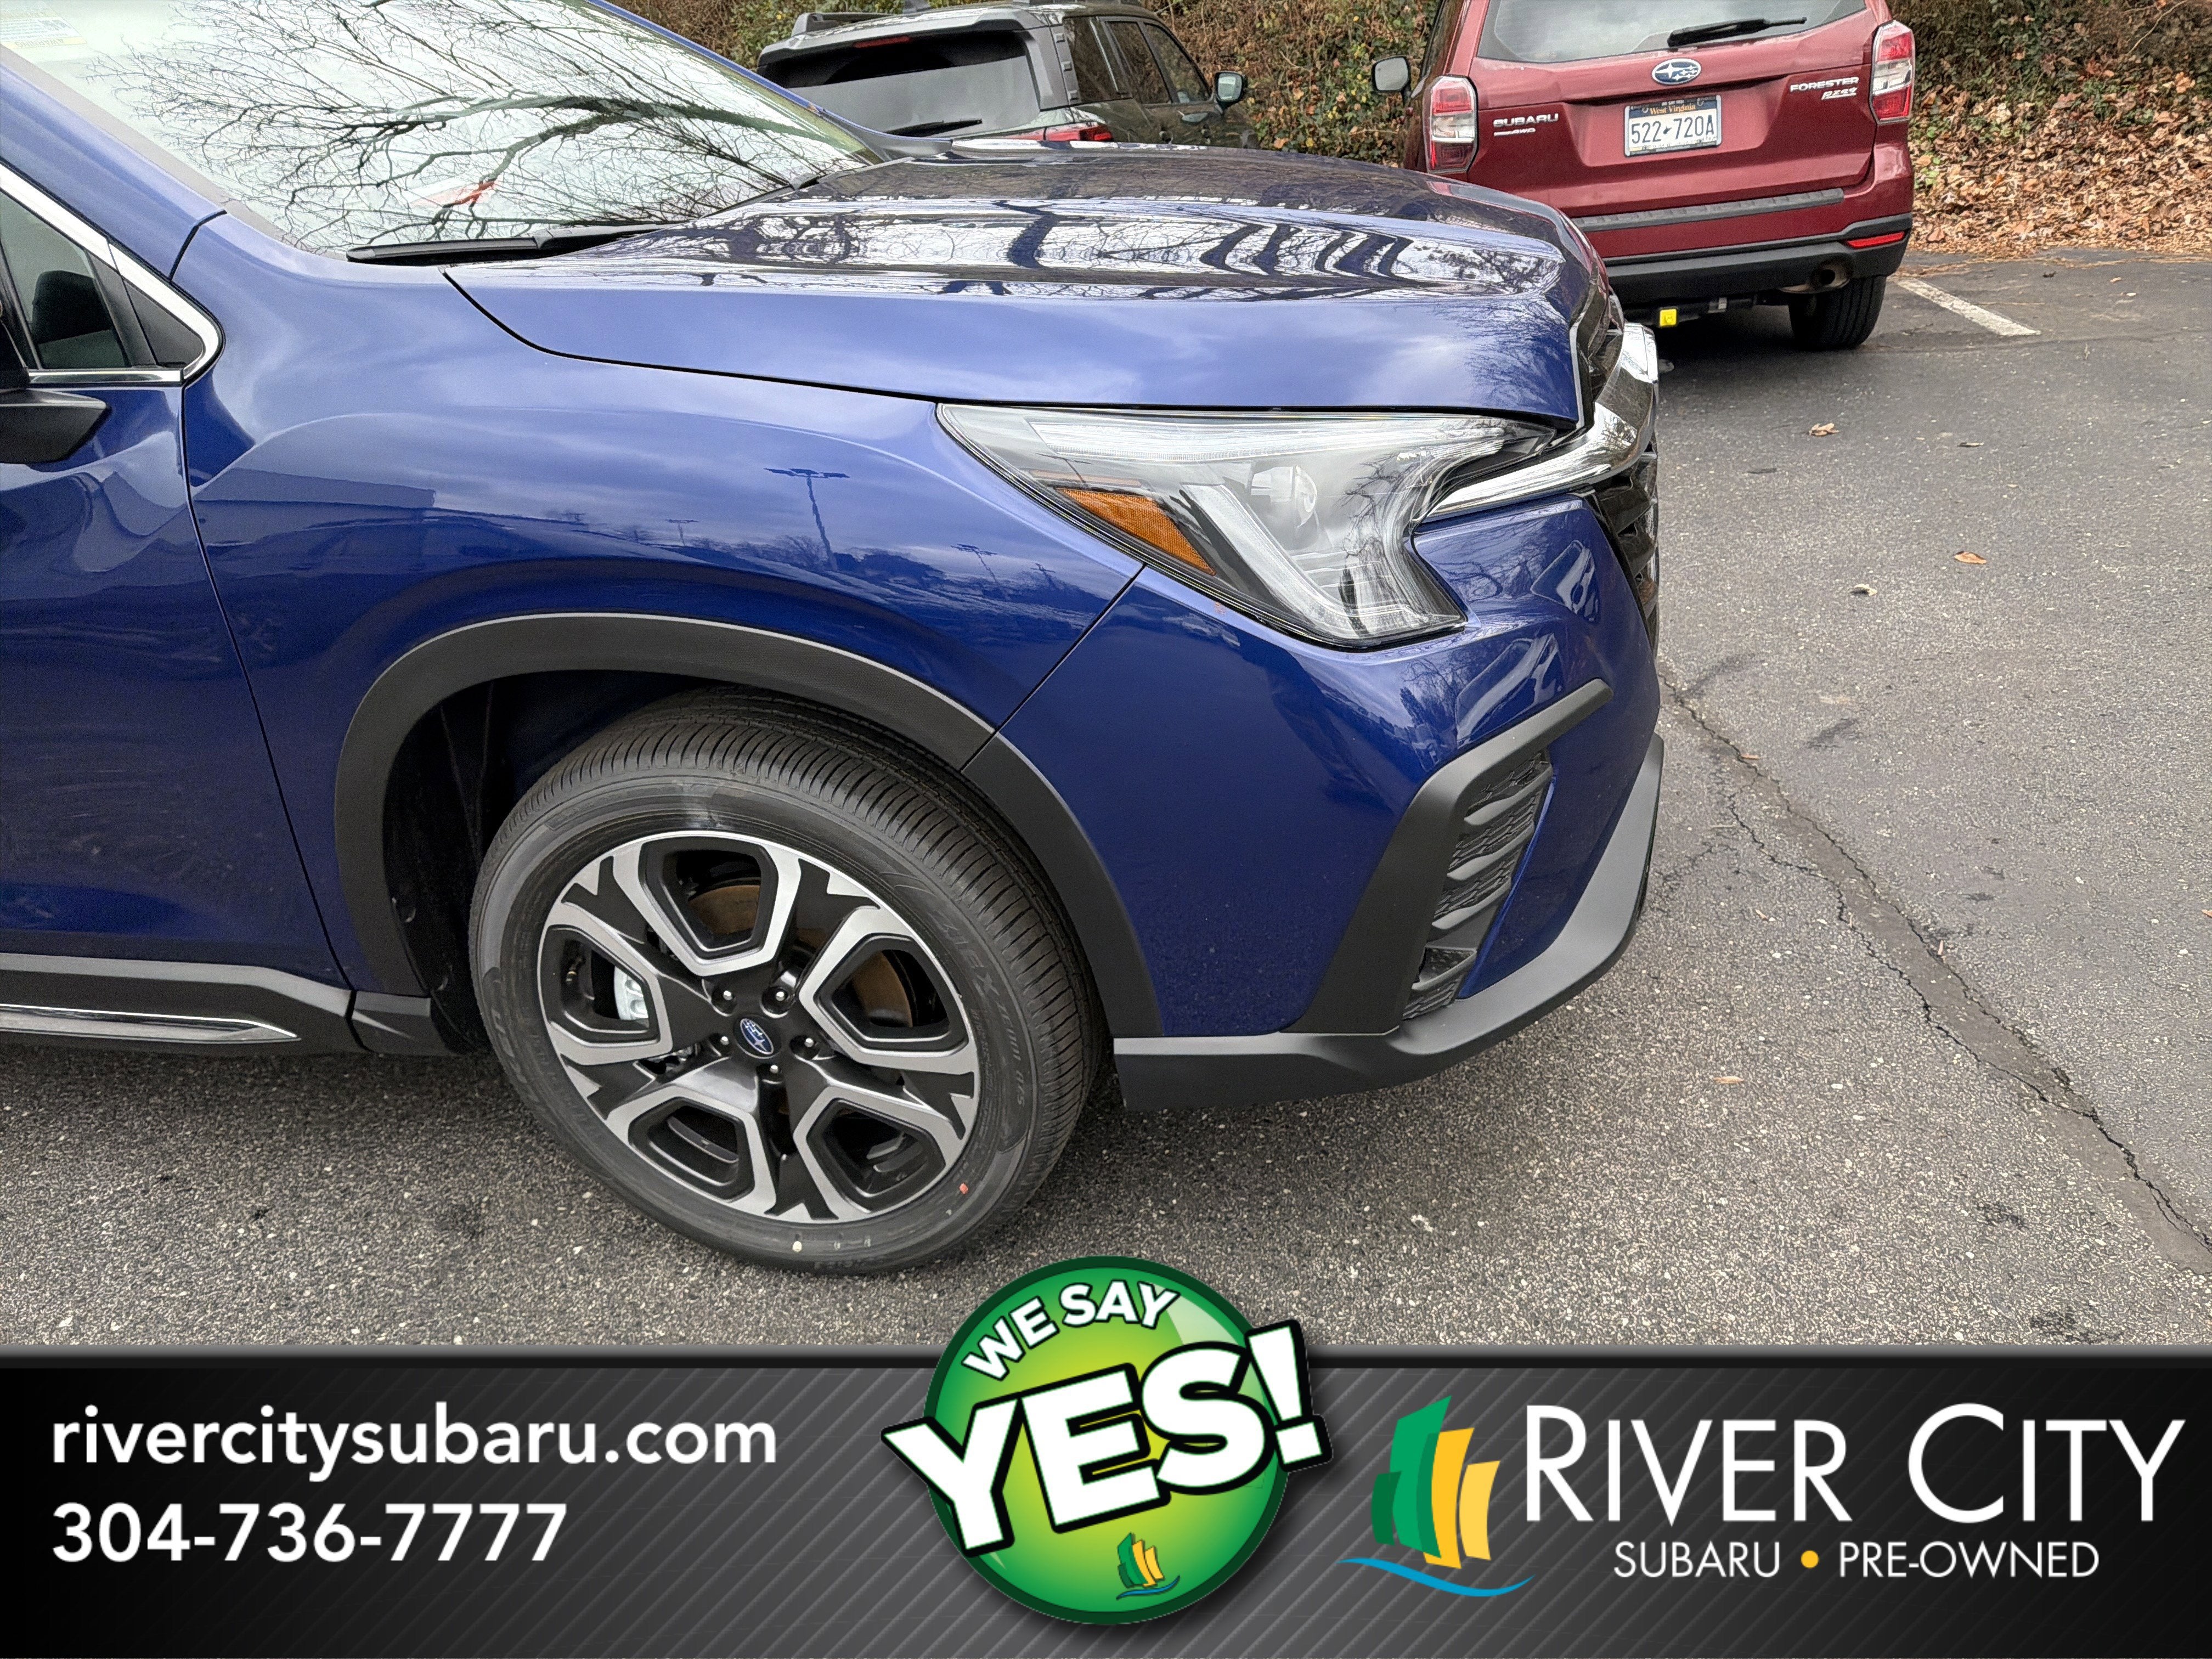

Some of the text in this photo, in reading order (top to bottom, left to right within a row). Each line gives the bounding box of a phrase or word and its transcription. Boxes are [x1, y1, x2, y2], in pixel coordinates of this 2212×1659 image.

[1790, 77, 1859, 92] FORESTER
[1668, 103, 1696, 114] Virginia
[1493, 113, 1559, 127] SUBARU
